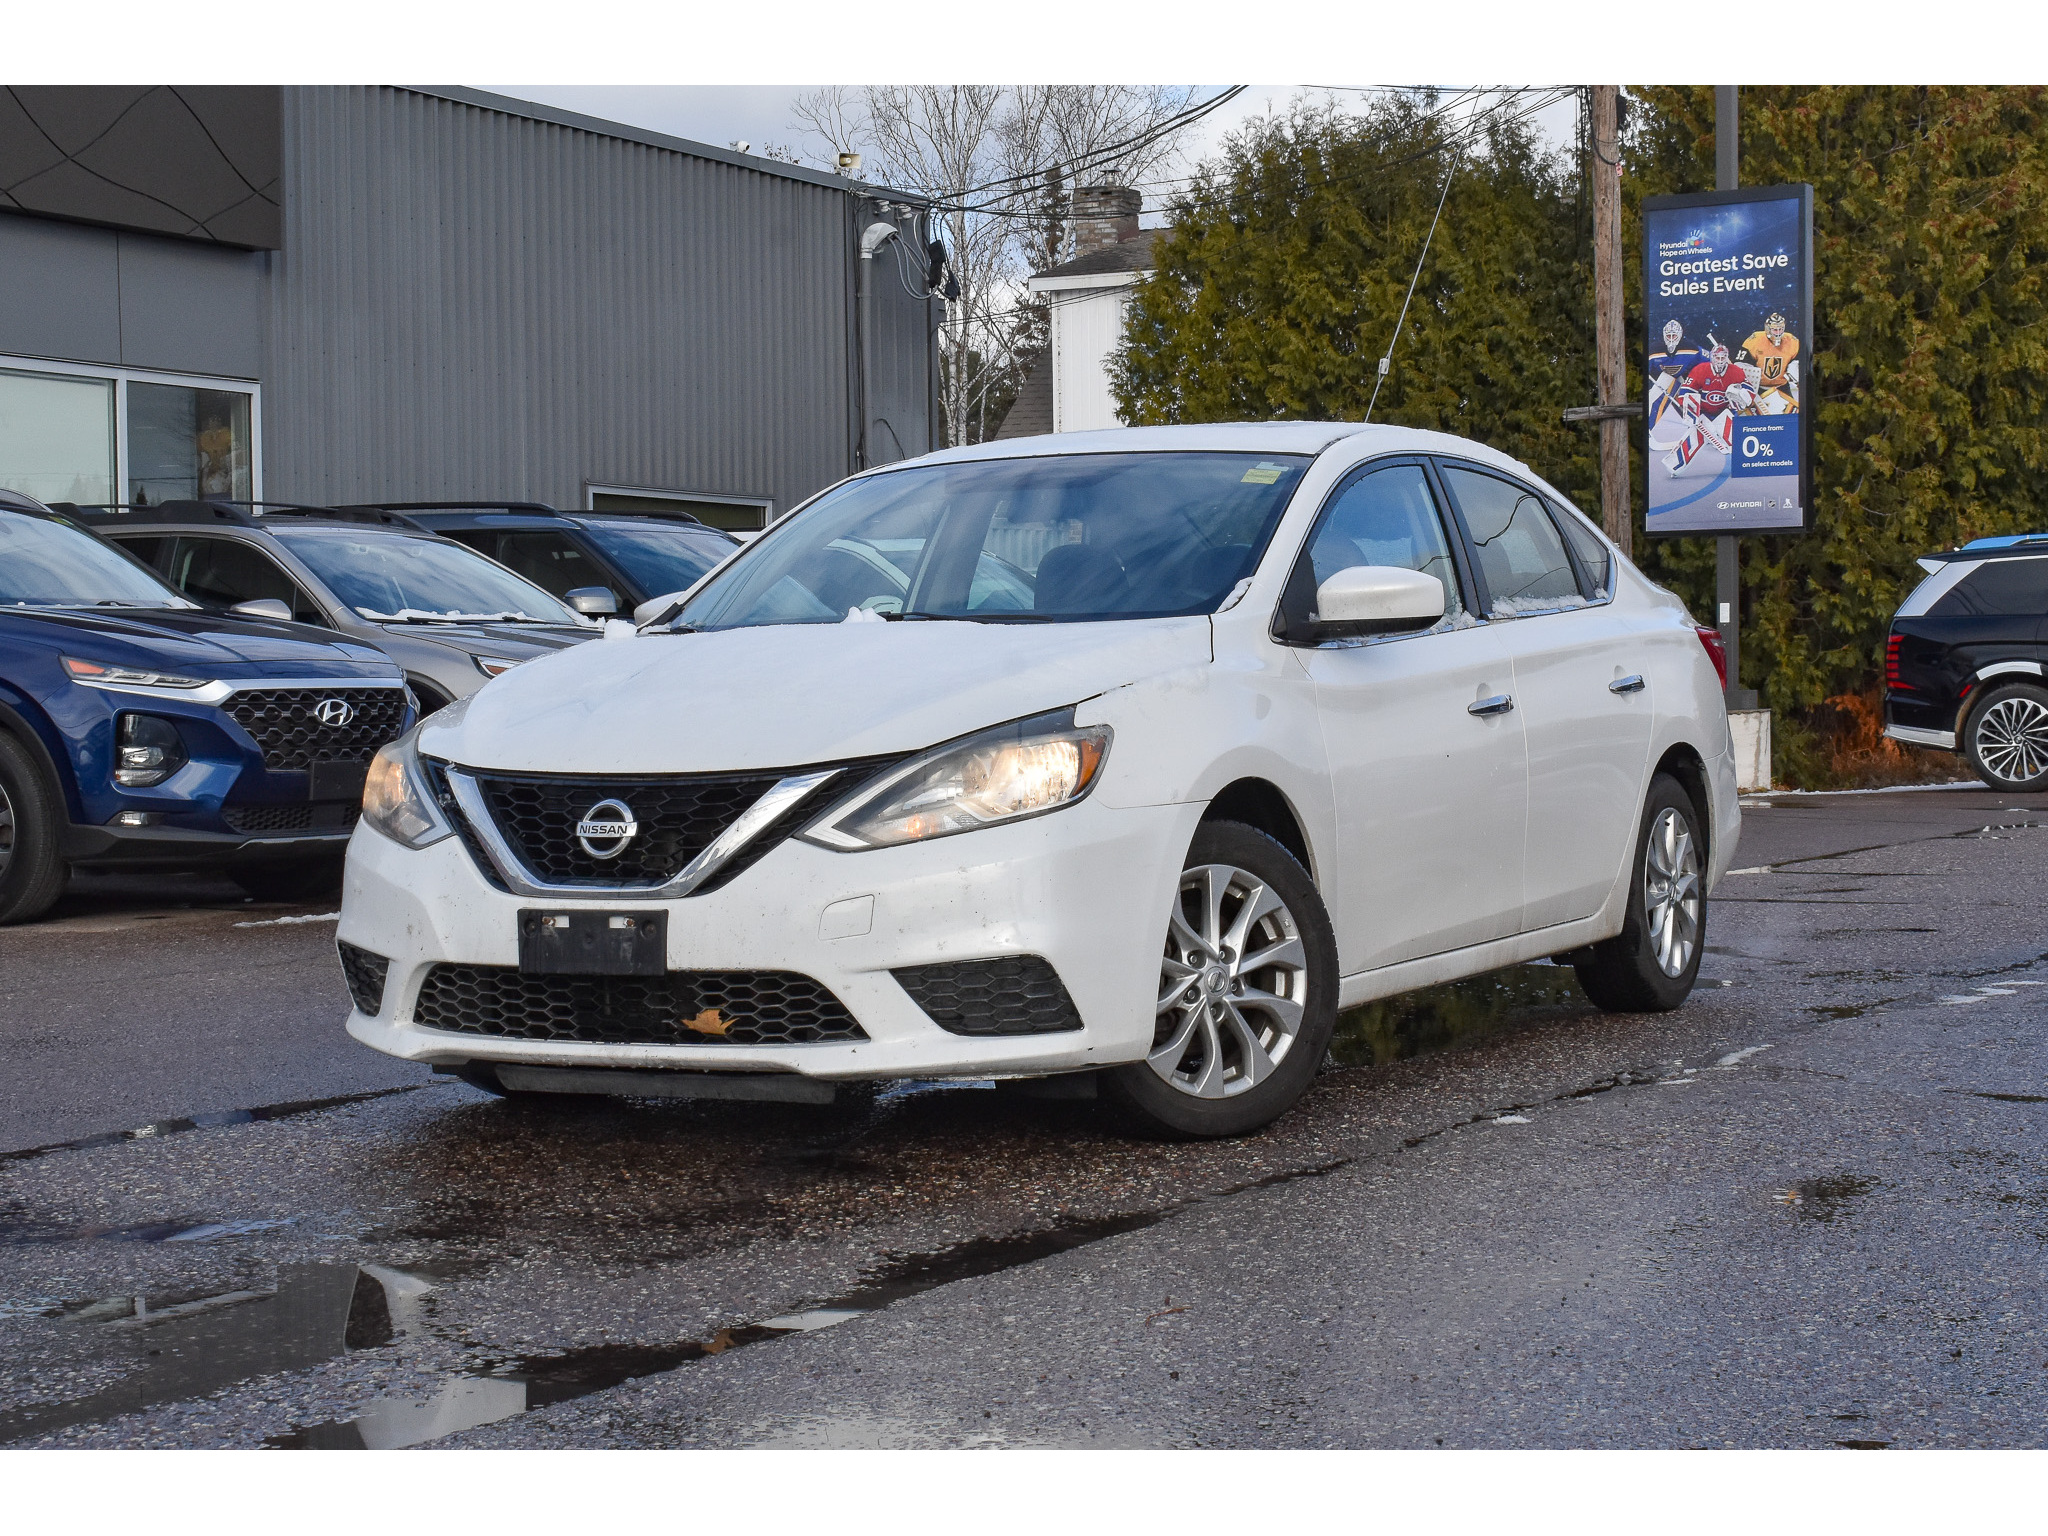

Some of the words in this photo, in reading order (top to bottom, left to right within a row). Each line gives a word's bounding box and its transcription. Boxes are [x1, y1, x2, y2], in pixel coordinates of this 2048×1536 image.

[1660, 241, 1688, 250] Hyundai
[1688, 247, 1712, 255] Wheels
[1660, 256, 1738, 276] Greatest
[1742, 253, 1788, 270] Save
[1660, 279, 1709, 297] Sales
[1713, 274, 1765, 293] Event
[1742, 435, 1774, 458] 0%
[579, 825, 628, 835] NISSAN
